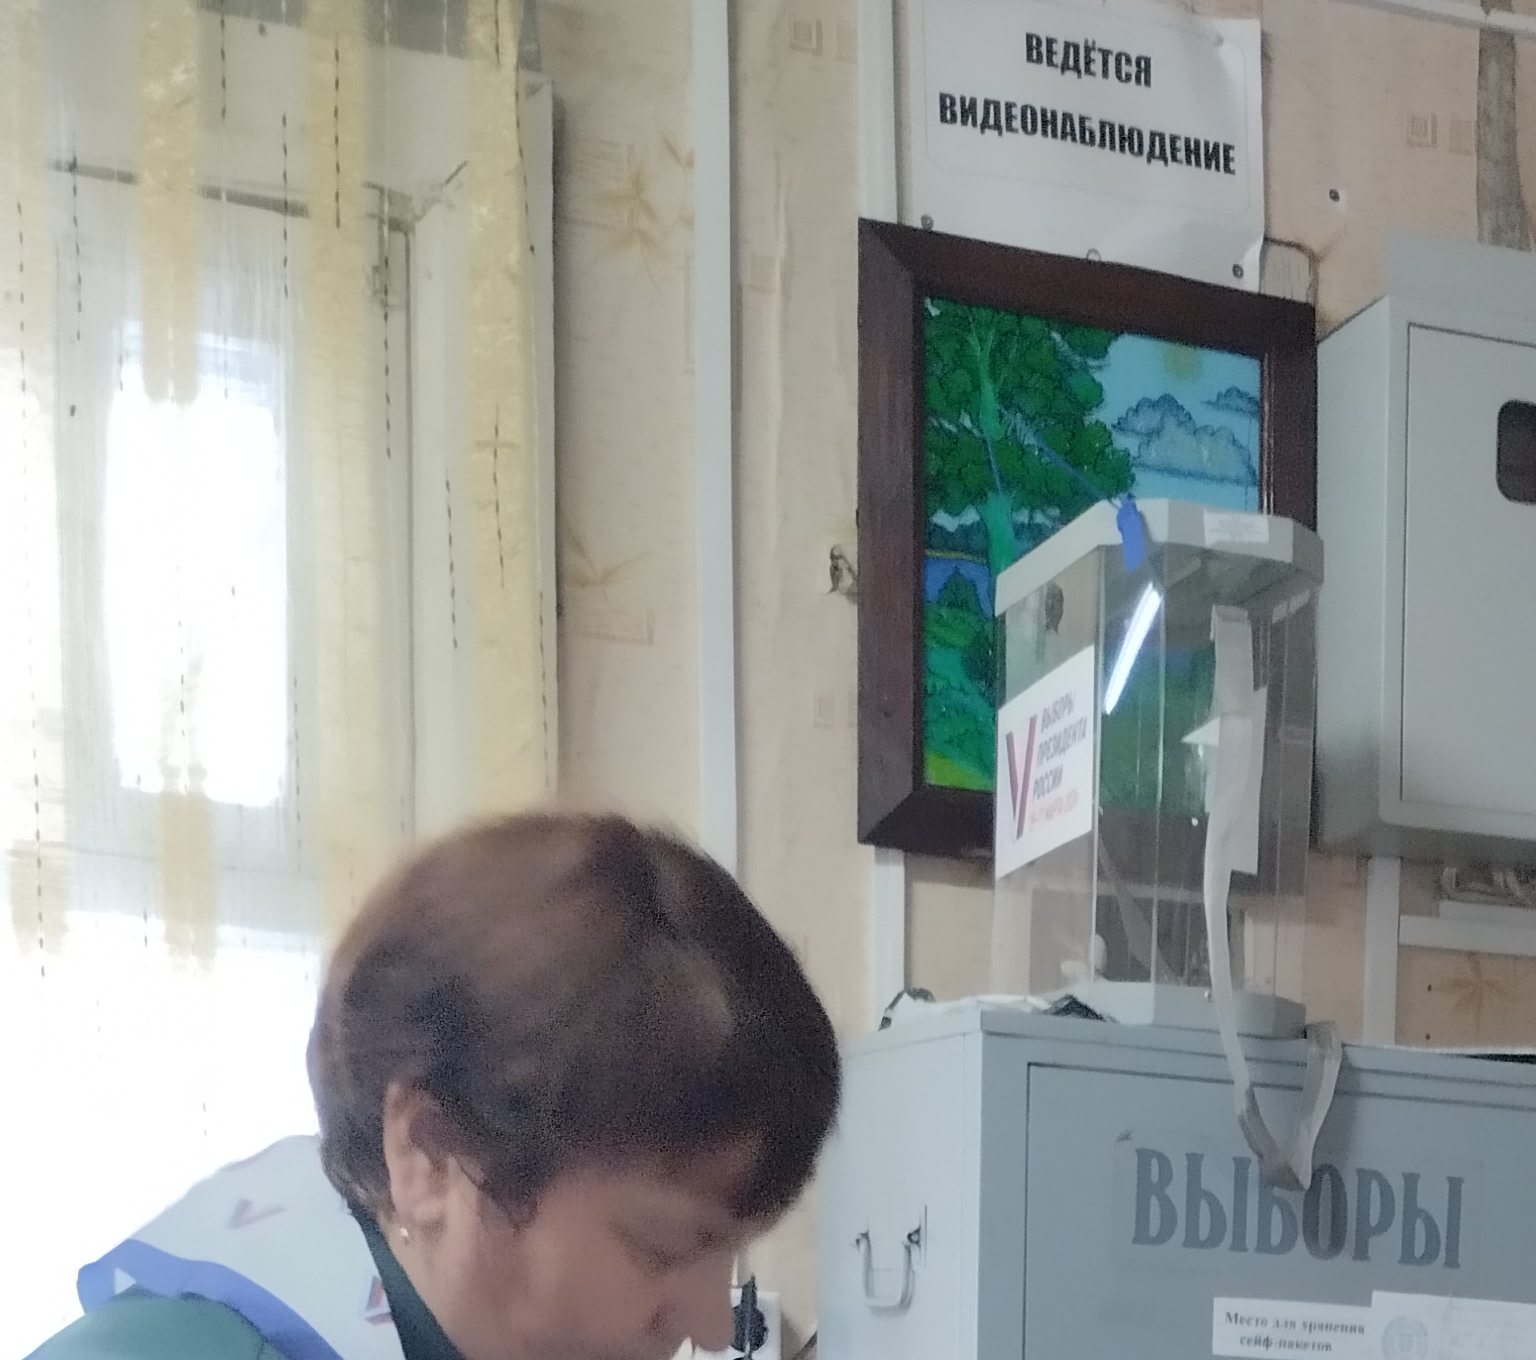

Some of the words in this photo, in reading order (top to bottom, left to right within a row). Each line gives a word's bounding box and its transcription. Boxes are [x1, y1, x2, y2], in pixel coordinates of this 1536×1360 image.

[1025, 32, 1152, 88] ВЕДЁТСЯ
[939, 92, 1237, 176] ВИДЕОНАБЛЮДЕНИЕ
[1225, 1311, 1268, 1328] Место
[1272, 1317, 1297, 1331] для
[1301, 1319, 1365, 1335] хранения
